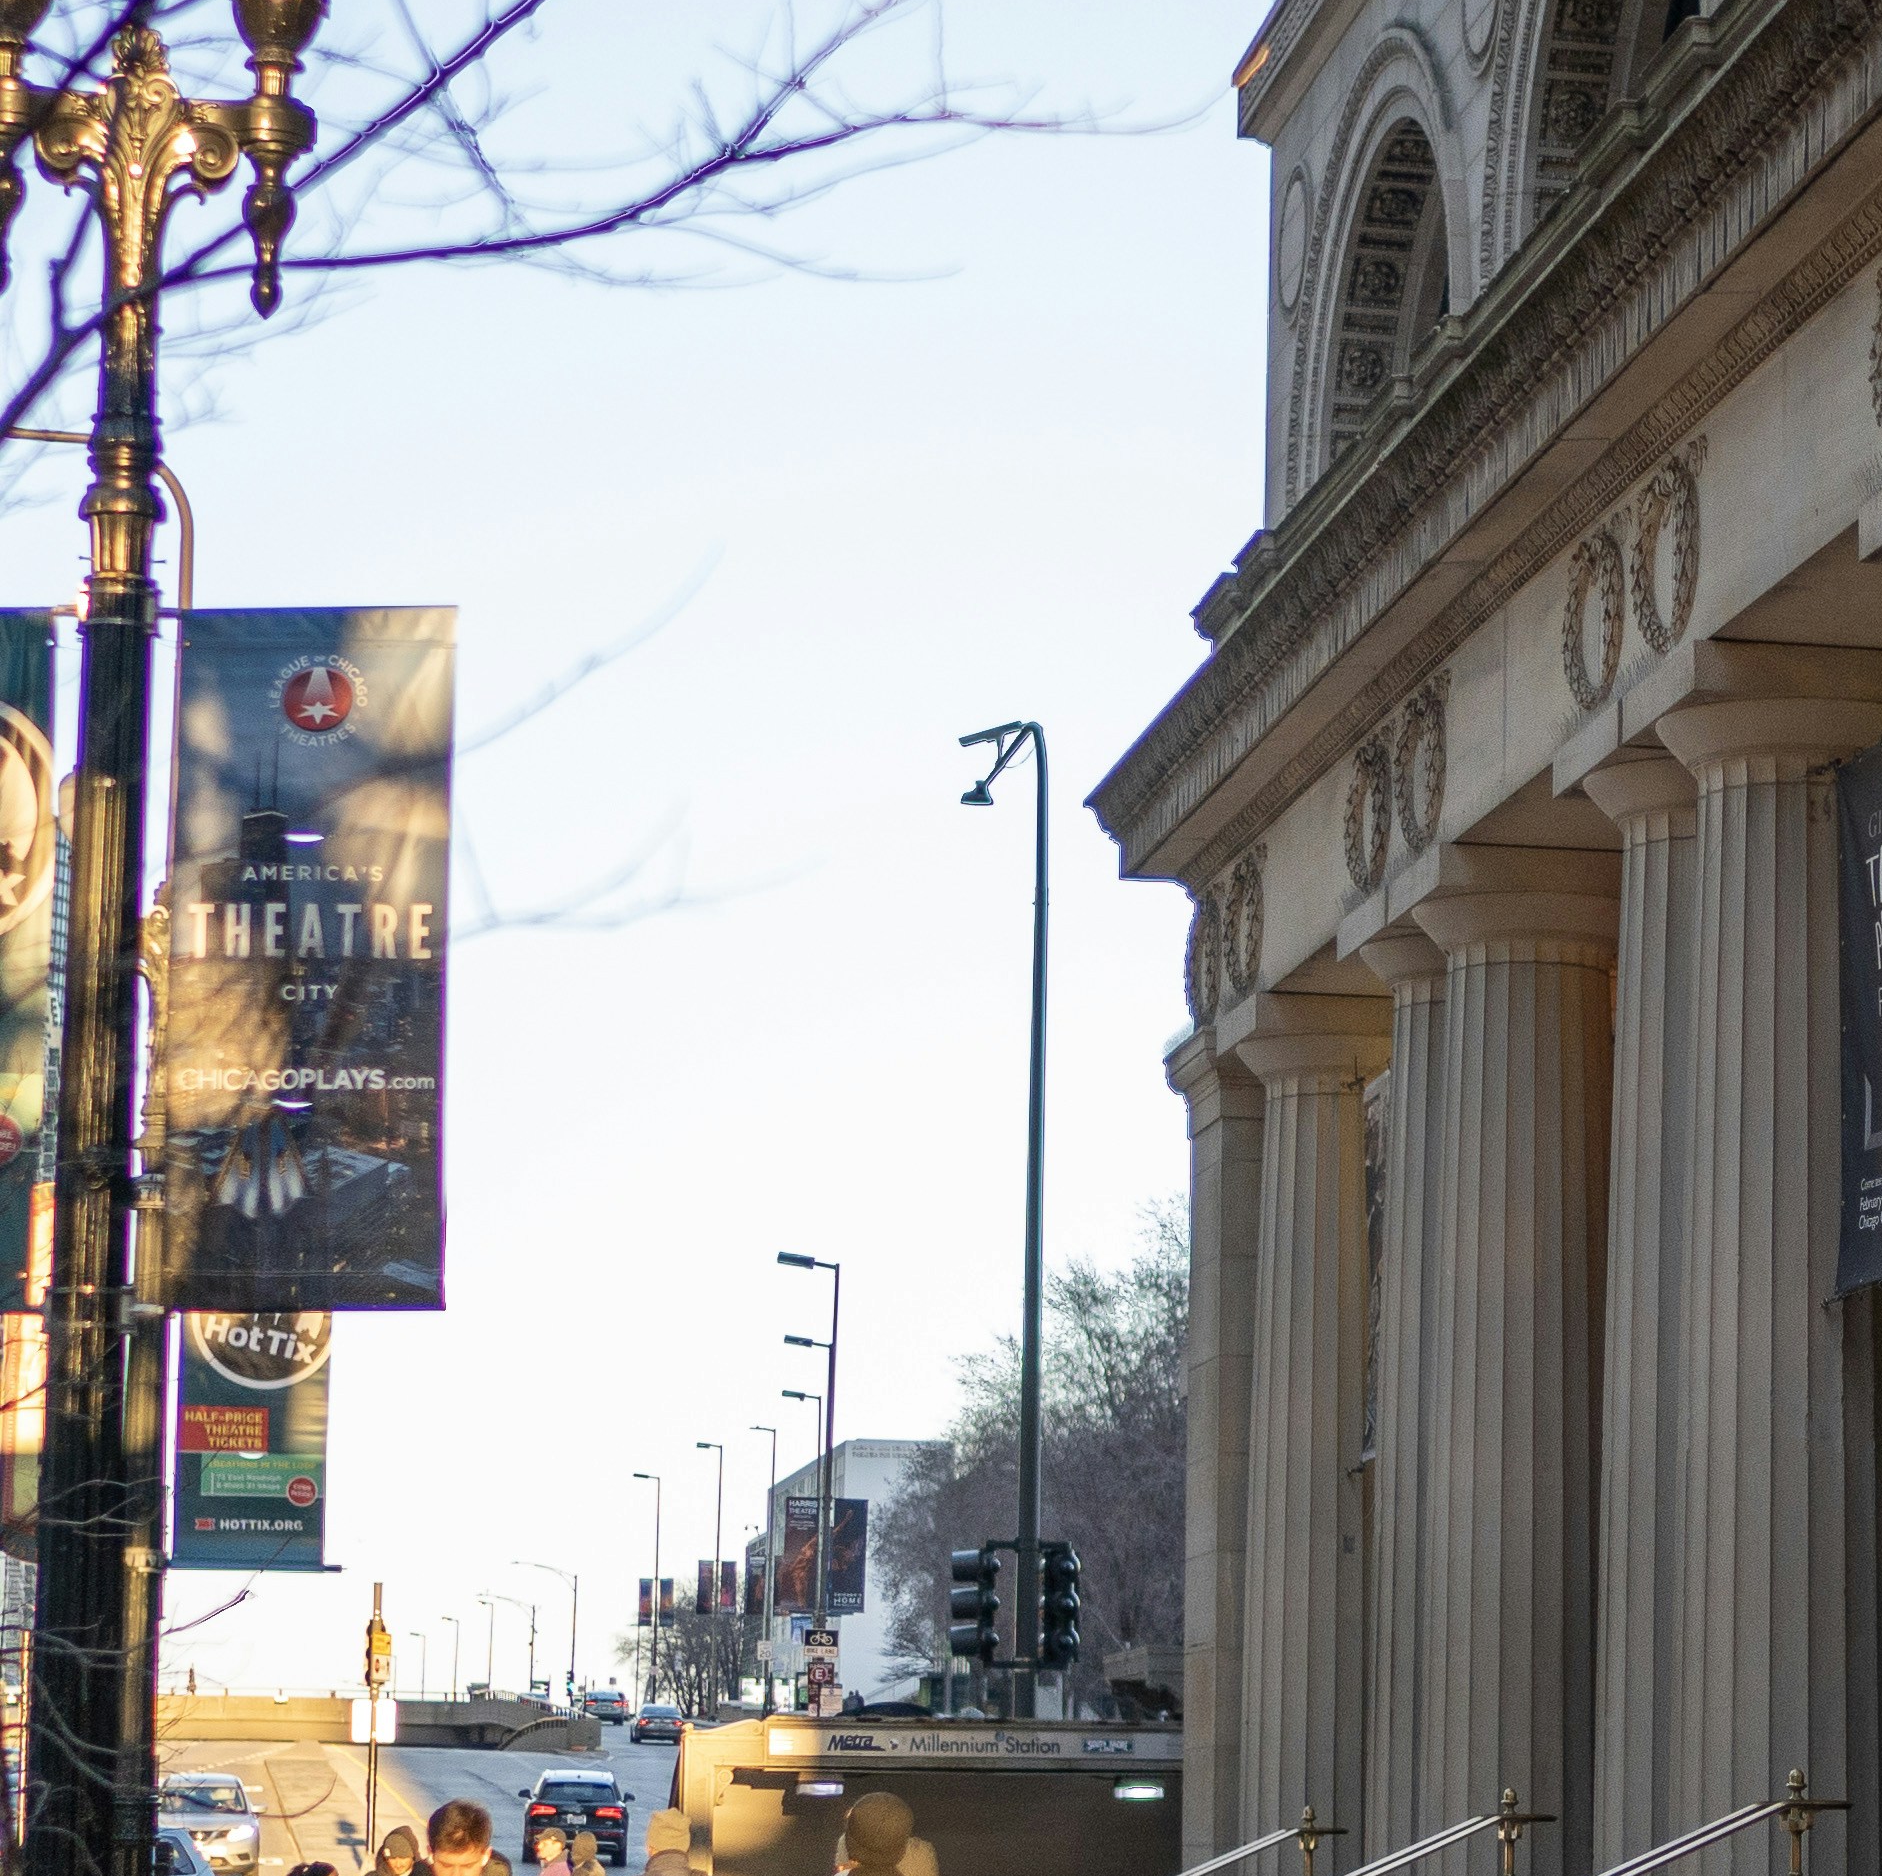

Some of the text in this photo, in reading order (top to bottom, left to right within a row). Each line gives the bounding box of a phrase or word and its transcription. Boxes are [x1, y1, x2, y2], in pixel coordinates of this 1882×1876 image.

[269, 655, 311, 709] LEAGUE
[328, 654, 368, 707] CHICAGO
[280, 723, 357, 746] THEATRES
[242, 865, 384, 882] AMERICA'S
[188, 902, 434, 960] THEATRE
[280, 983, 339, 1001] CITY
[179, 1067, 435, 1092] CHICAGOPLAYS.com
[185, 1410, 263, 1424] HALF-PRICE
[204, 1424, 263, 1436] THEATRE
[208, 1436, 263, 1449] TICKETS
[219, 1519, 304, 1531] HOTTIX.ORG
[827, 1733, 1061, 1754] Metra Millennium Station
